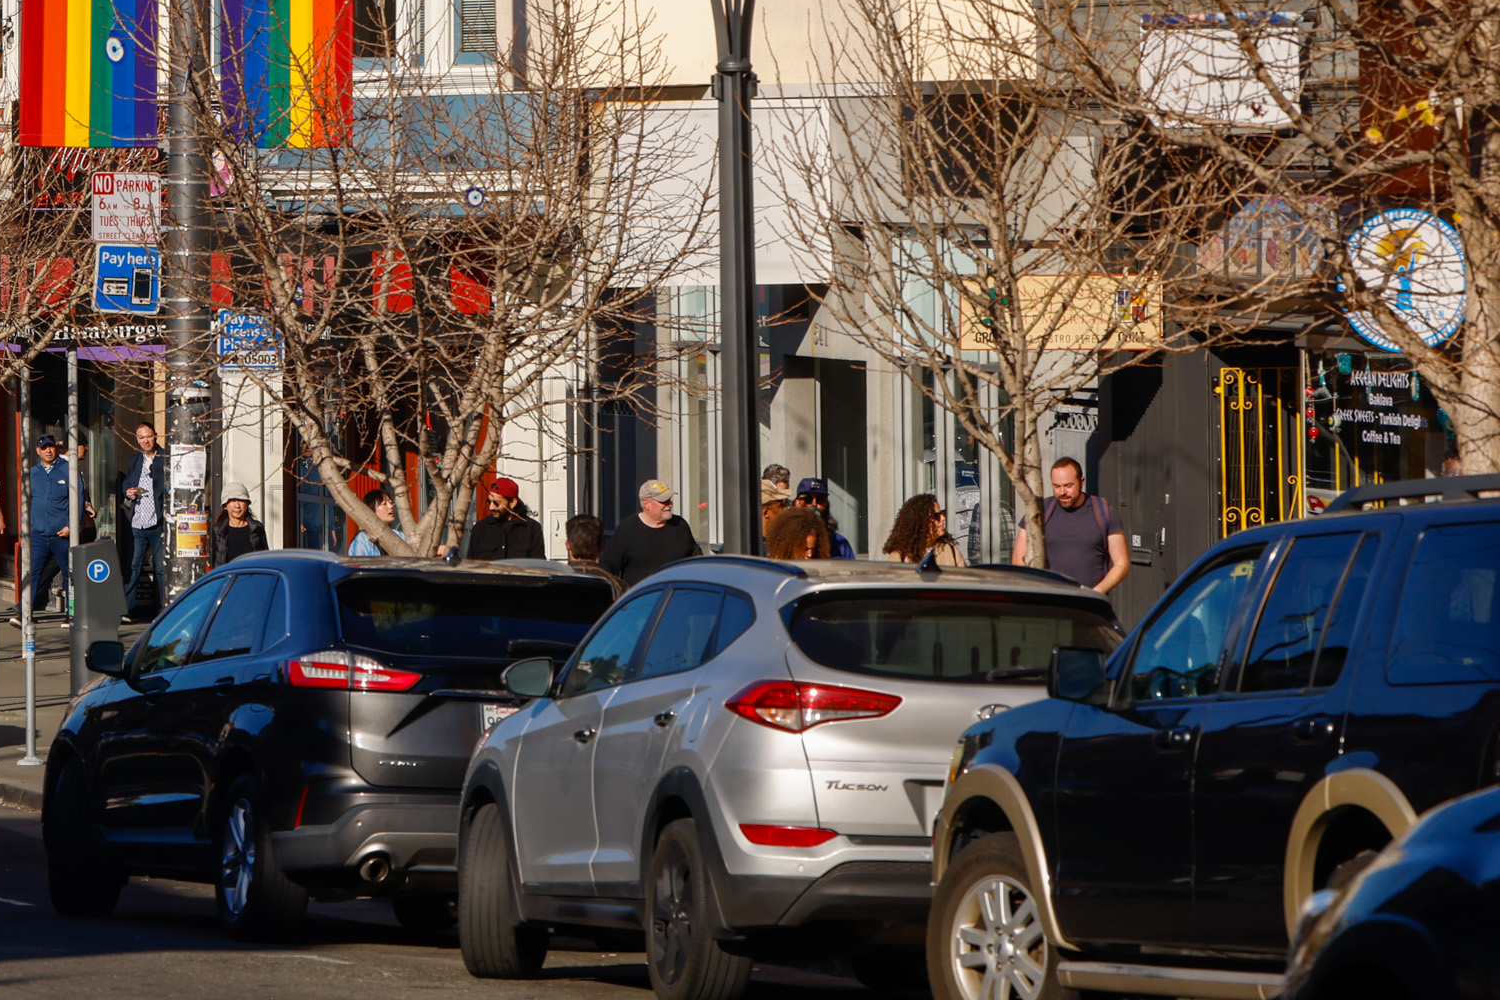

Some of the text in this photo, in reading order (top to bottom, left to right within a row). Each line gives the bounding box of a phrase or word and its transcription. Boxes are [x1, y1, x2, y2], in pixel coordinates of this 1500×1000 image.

[95, 175, 157, 193] NO PARKING
[100, 216, 152, 227] TUES THURS
[98, 232, 156, 240] STREET CLEANING
[102, 252, 156, 267] Pay here
[223, 314, 246, 327] Pay
[223, 326, 268, 337] License
[1350, 370, 1410, 388] AEGEAN DELIGHTS
[1369, 393, 1394, 407] Baklava
[1354, 409, 1375, 423] SWEETS
[1379, 412, 1402, 426] Turkish
[1362, 430, 1402, 445] Coffee & Tea
[93, 564, 103, 578] P
